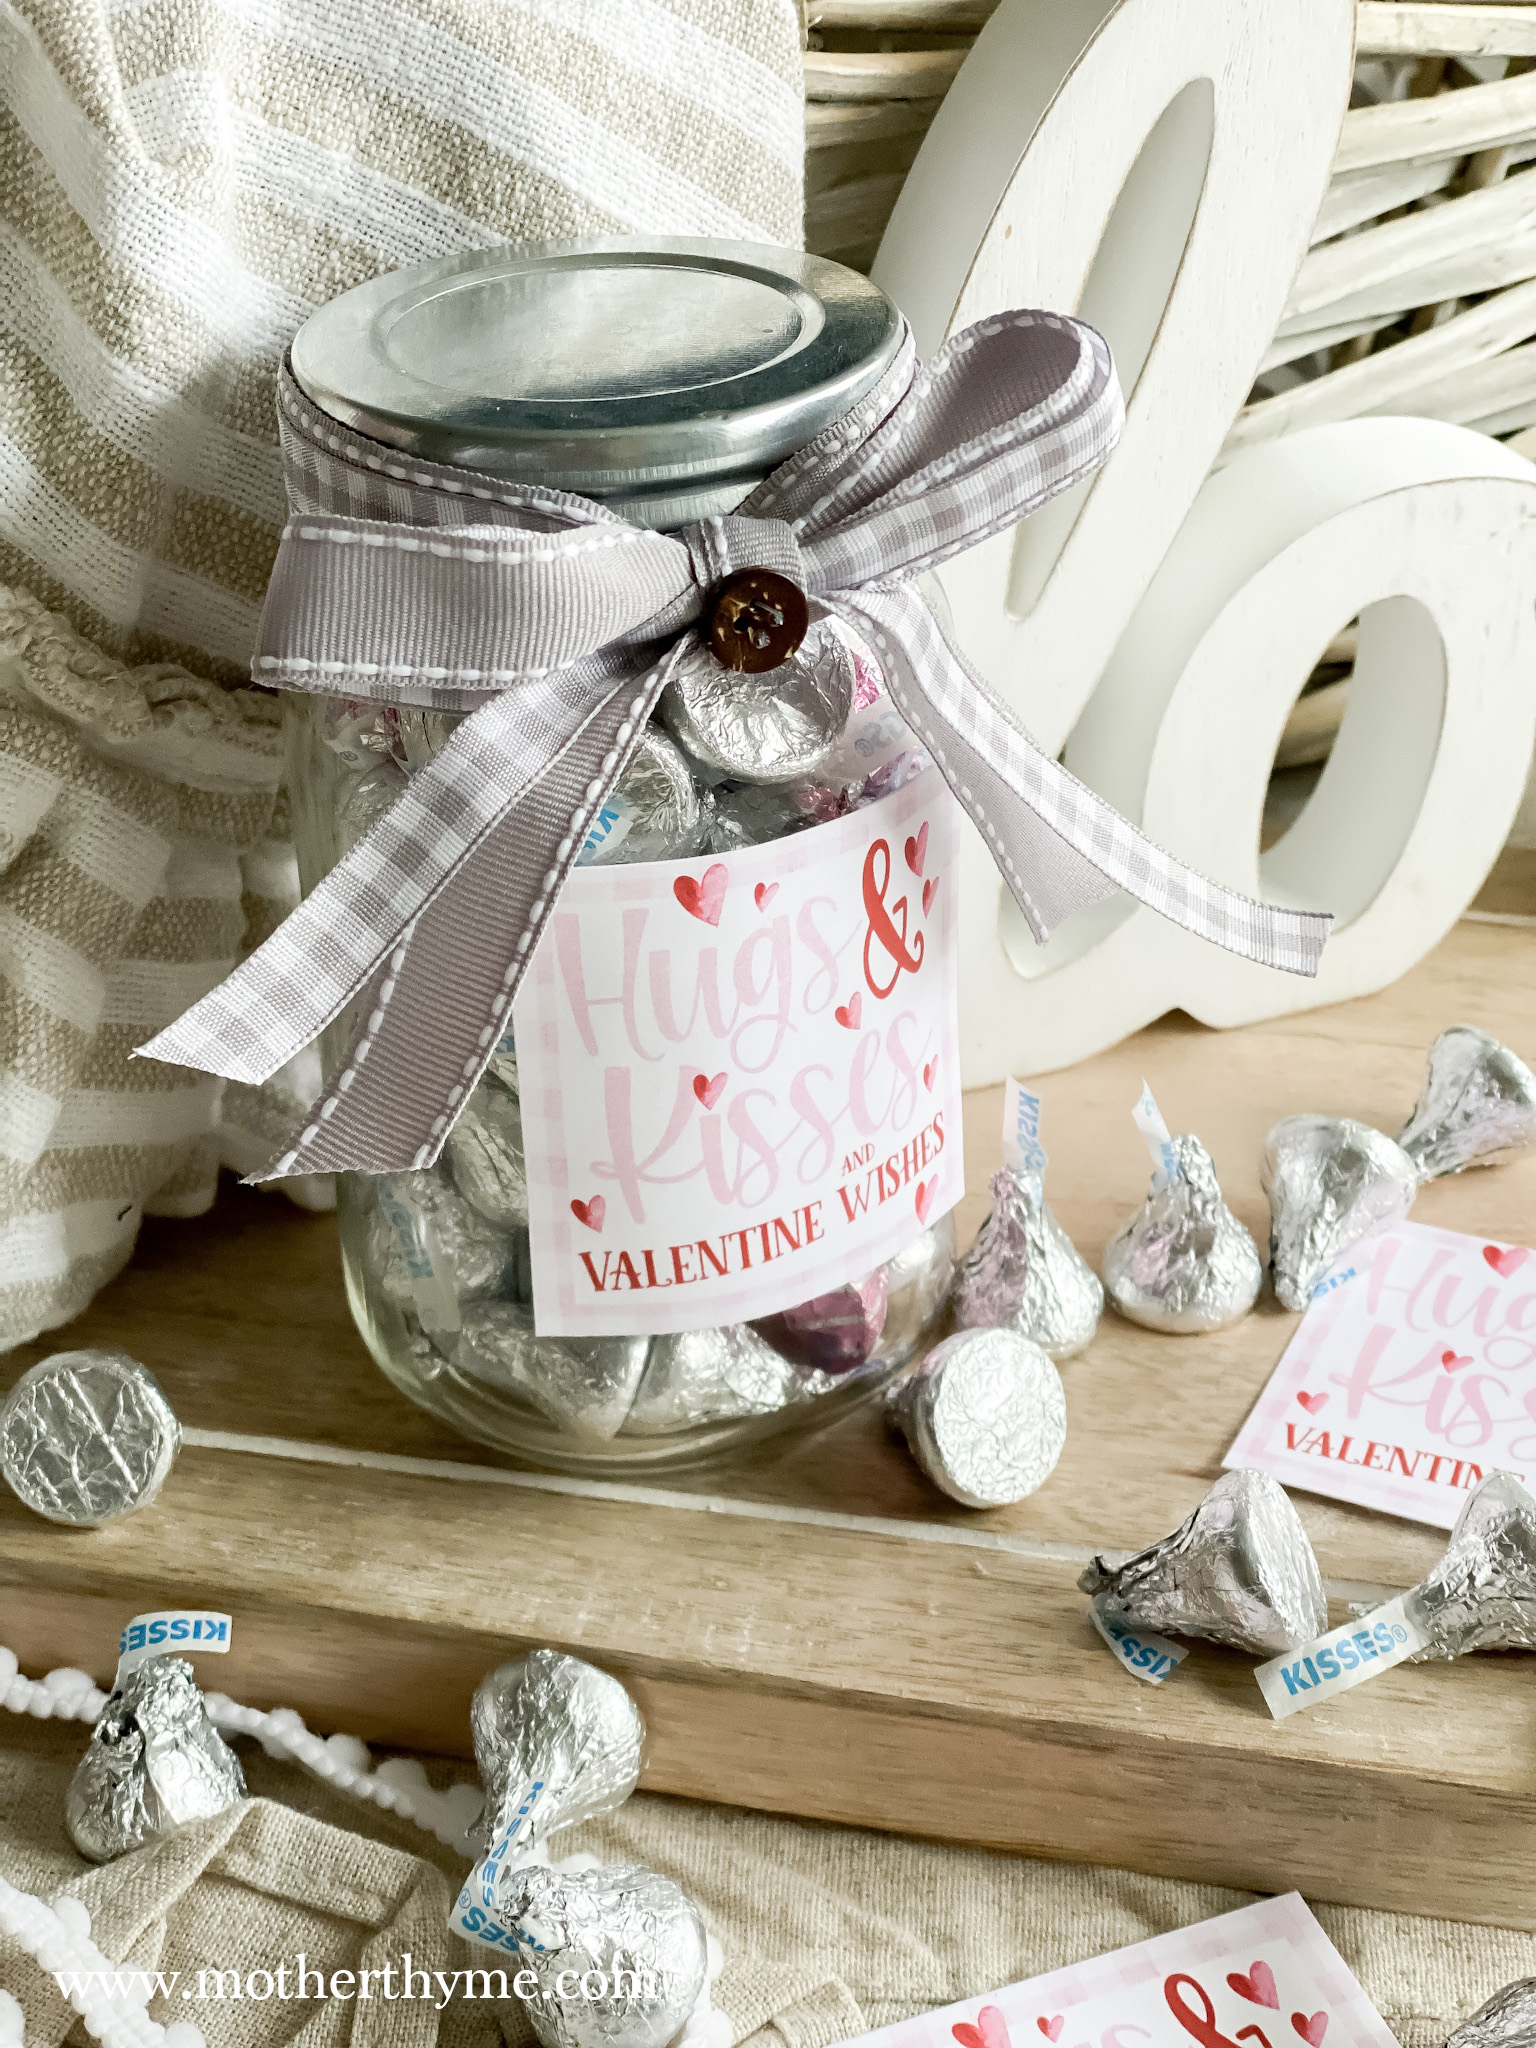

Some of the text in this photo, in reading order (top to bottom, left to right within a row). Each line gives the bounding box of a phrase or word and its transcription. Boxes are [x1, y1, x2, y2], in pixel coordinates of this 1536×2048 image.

[552, 838, 926, 1074] Hugs &
[589, 1010, 933, 1225] Kisses
[841, 1142, 876, 1177] AND
[578, 1109, 945, 1292] VALENTINE WISHES
[1284, 1421, 1526, 1491] VALENTIN
[482, 1781, 544, 1908] KISSES
